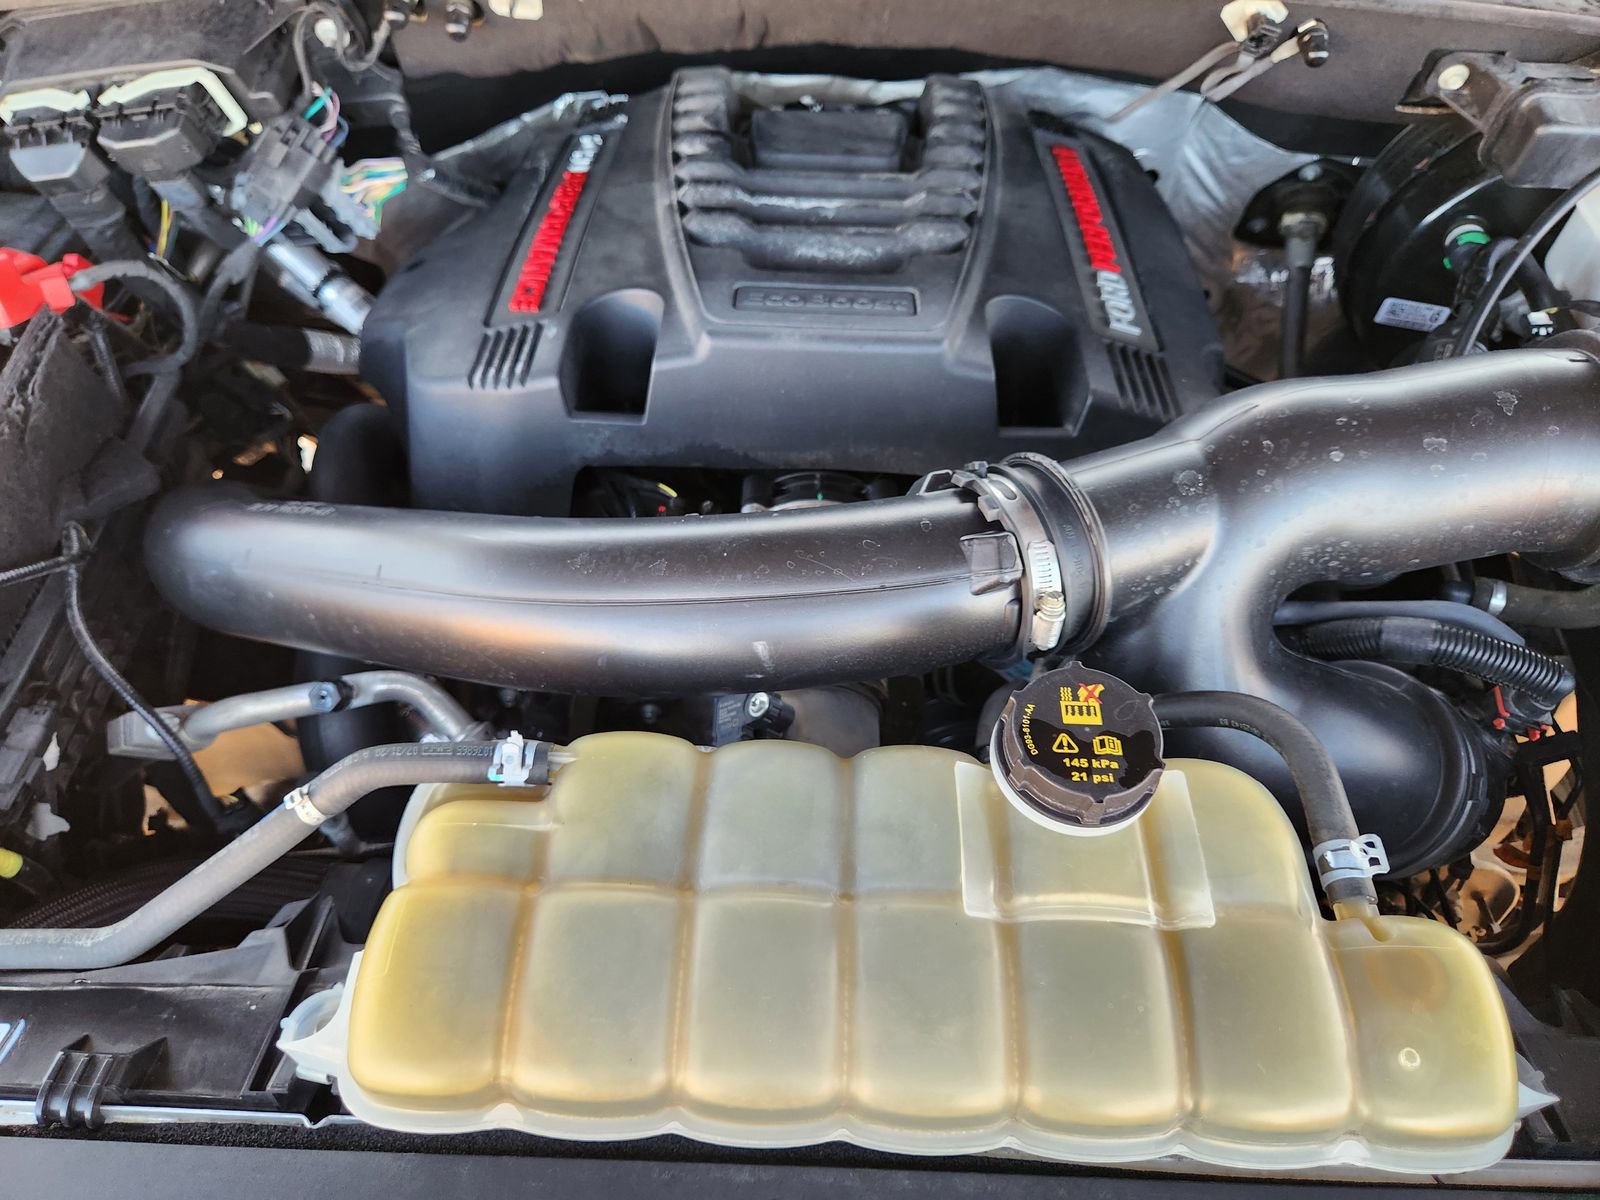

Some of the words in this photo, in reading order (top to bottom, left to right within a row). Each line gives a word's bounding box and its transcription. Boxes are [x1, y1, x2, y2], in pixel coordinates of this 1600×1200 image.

[1096, 270, 1142, 336] FORD
[1063, 758, 1089, 769] 145
[1092, 758, 1119, 769] kPa
[1071, 772, 1088, 782] 21
[1093, 773, 1115, 785] psi
